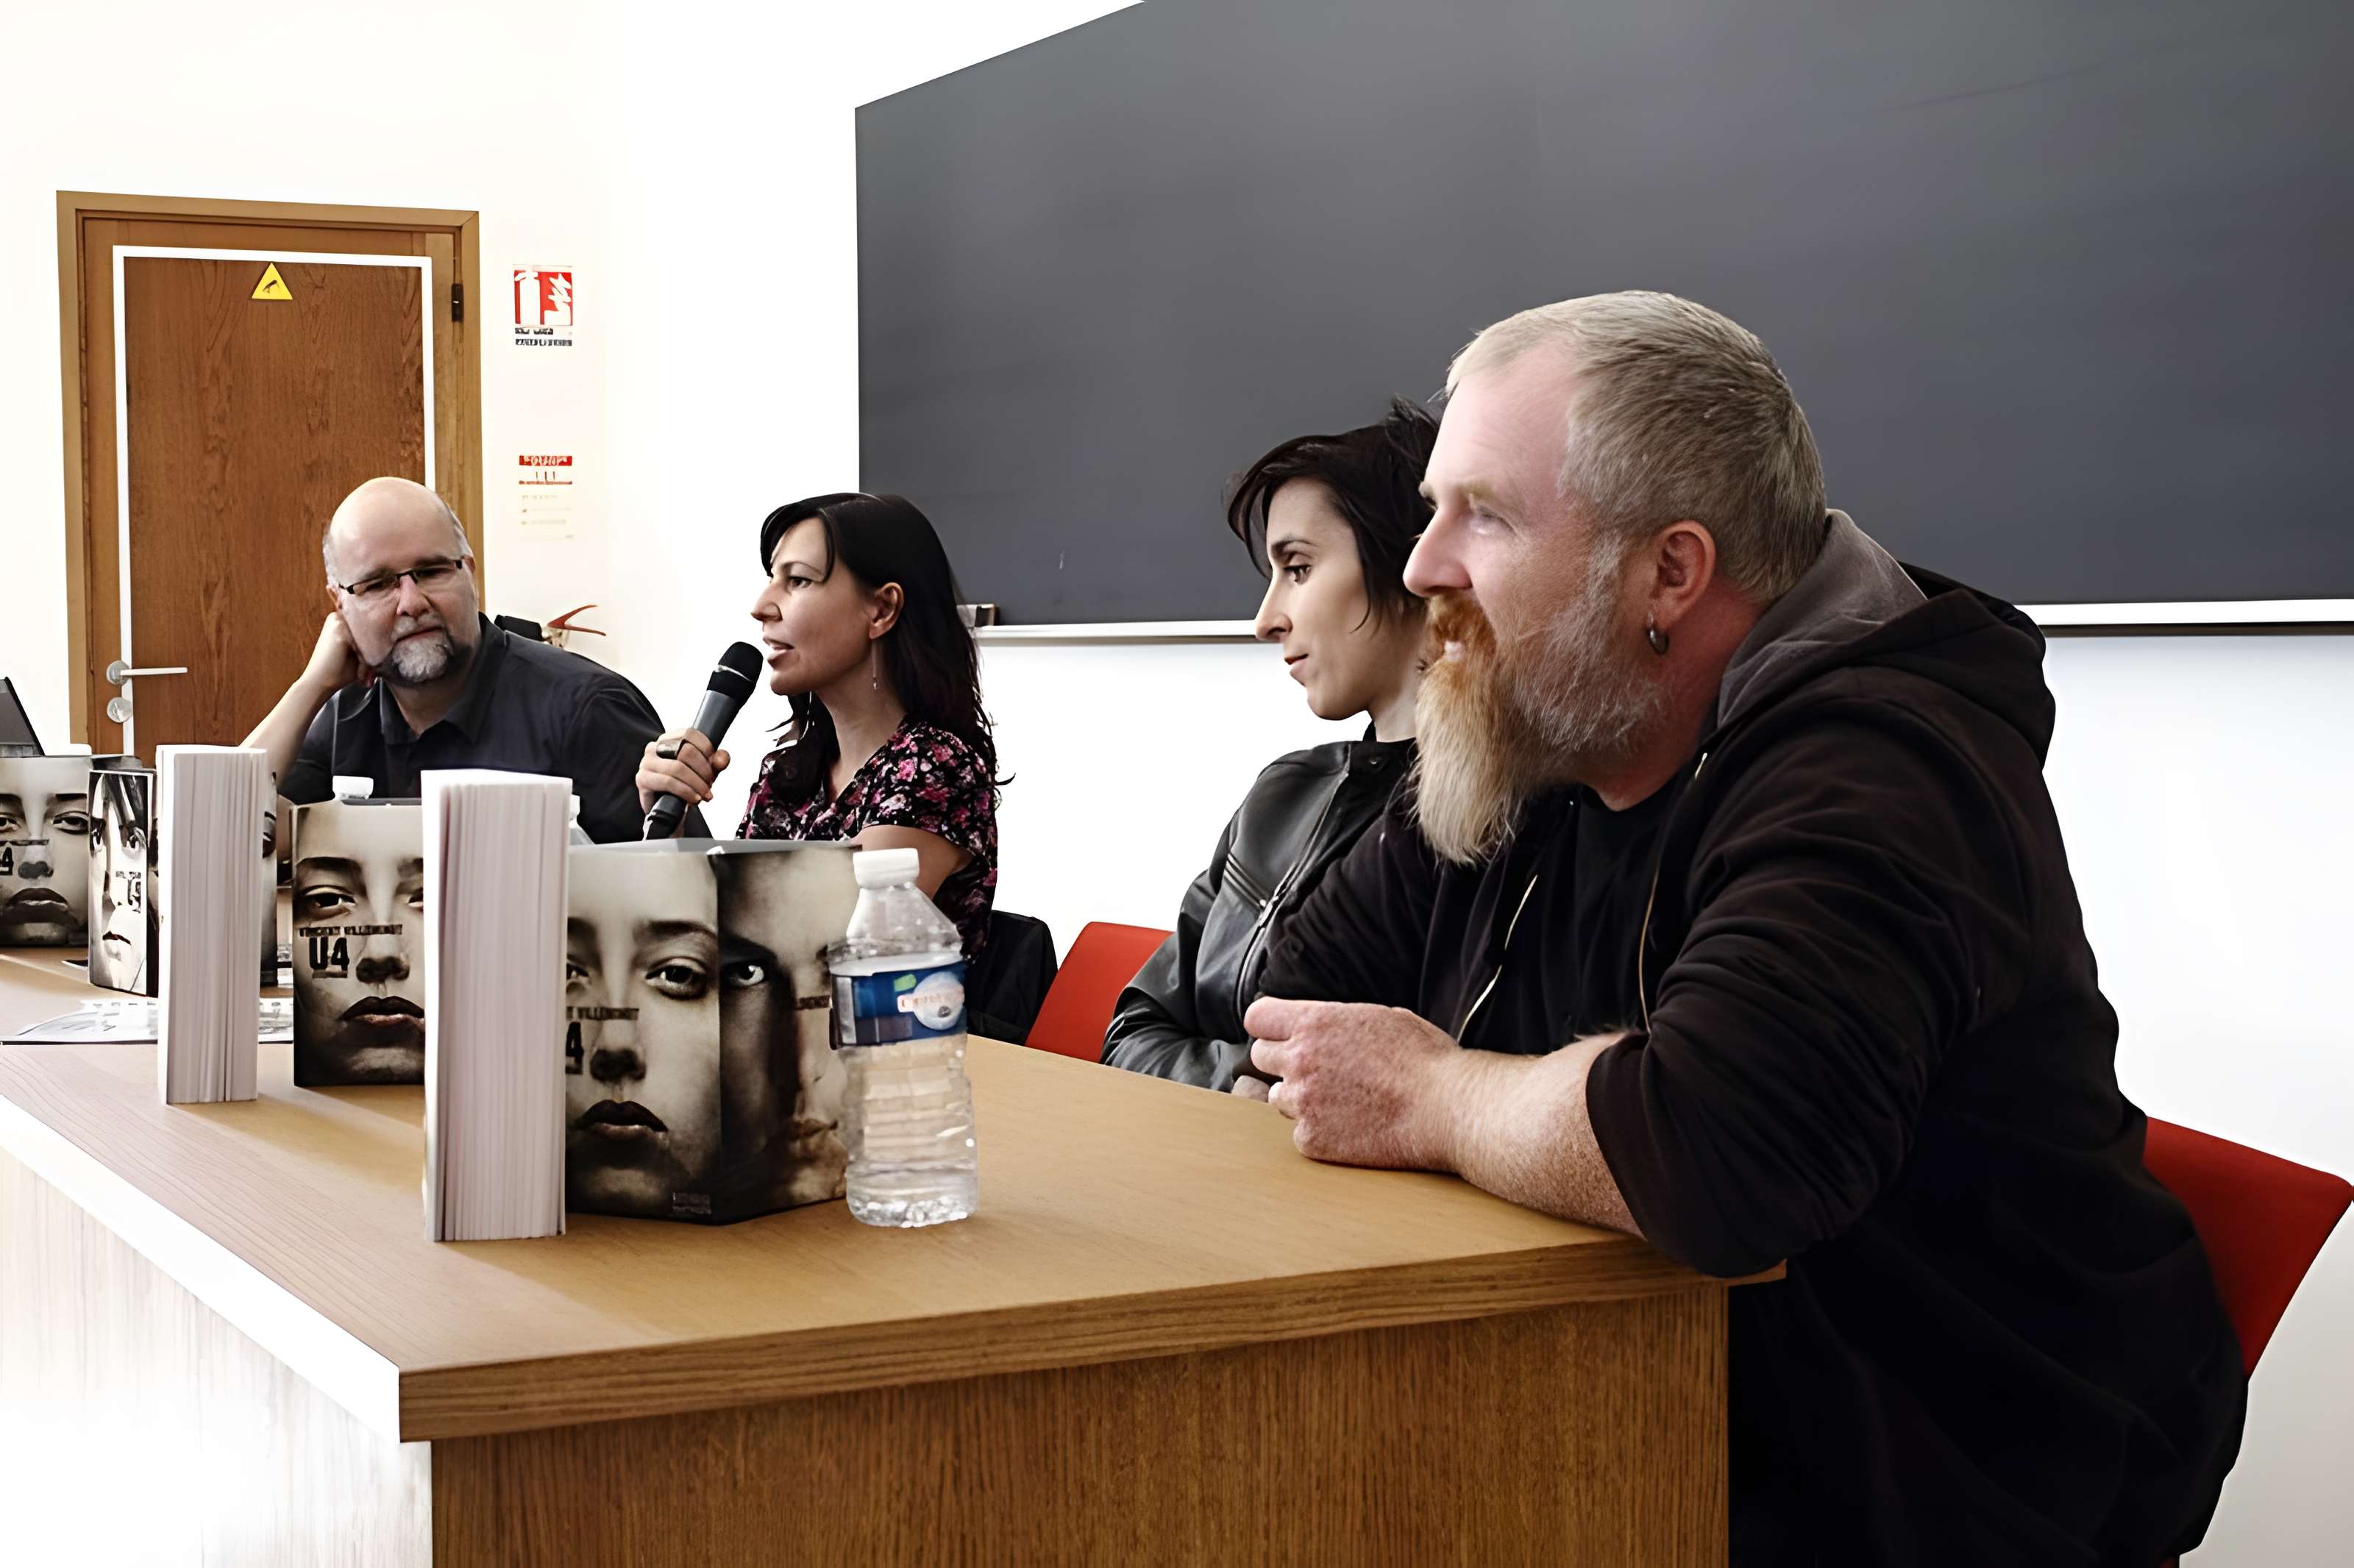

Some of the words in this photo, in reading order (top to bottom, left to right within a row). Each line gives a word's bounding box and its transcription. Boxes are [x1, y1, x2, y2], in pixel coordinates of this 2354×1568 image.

[0, 847, 14, 873] 4
[309, 935, 349, 972] U4
[566, 1022, 584, 1064] 4
